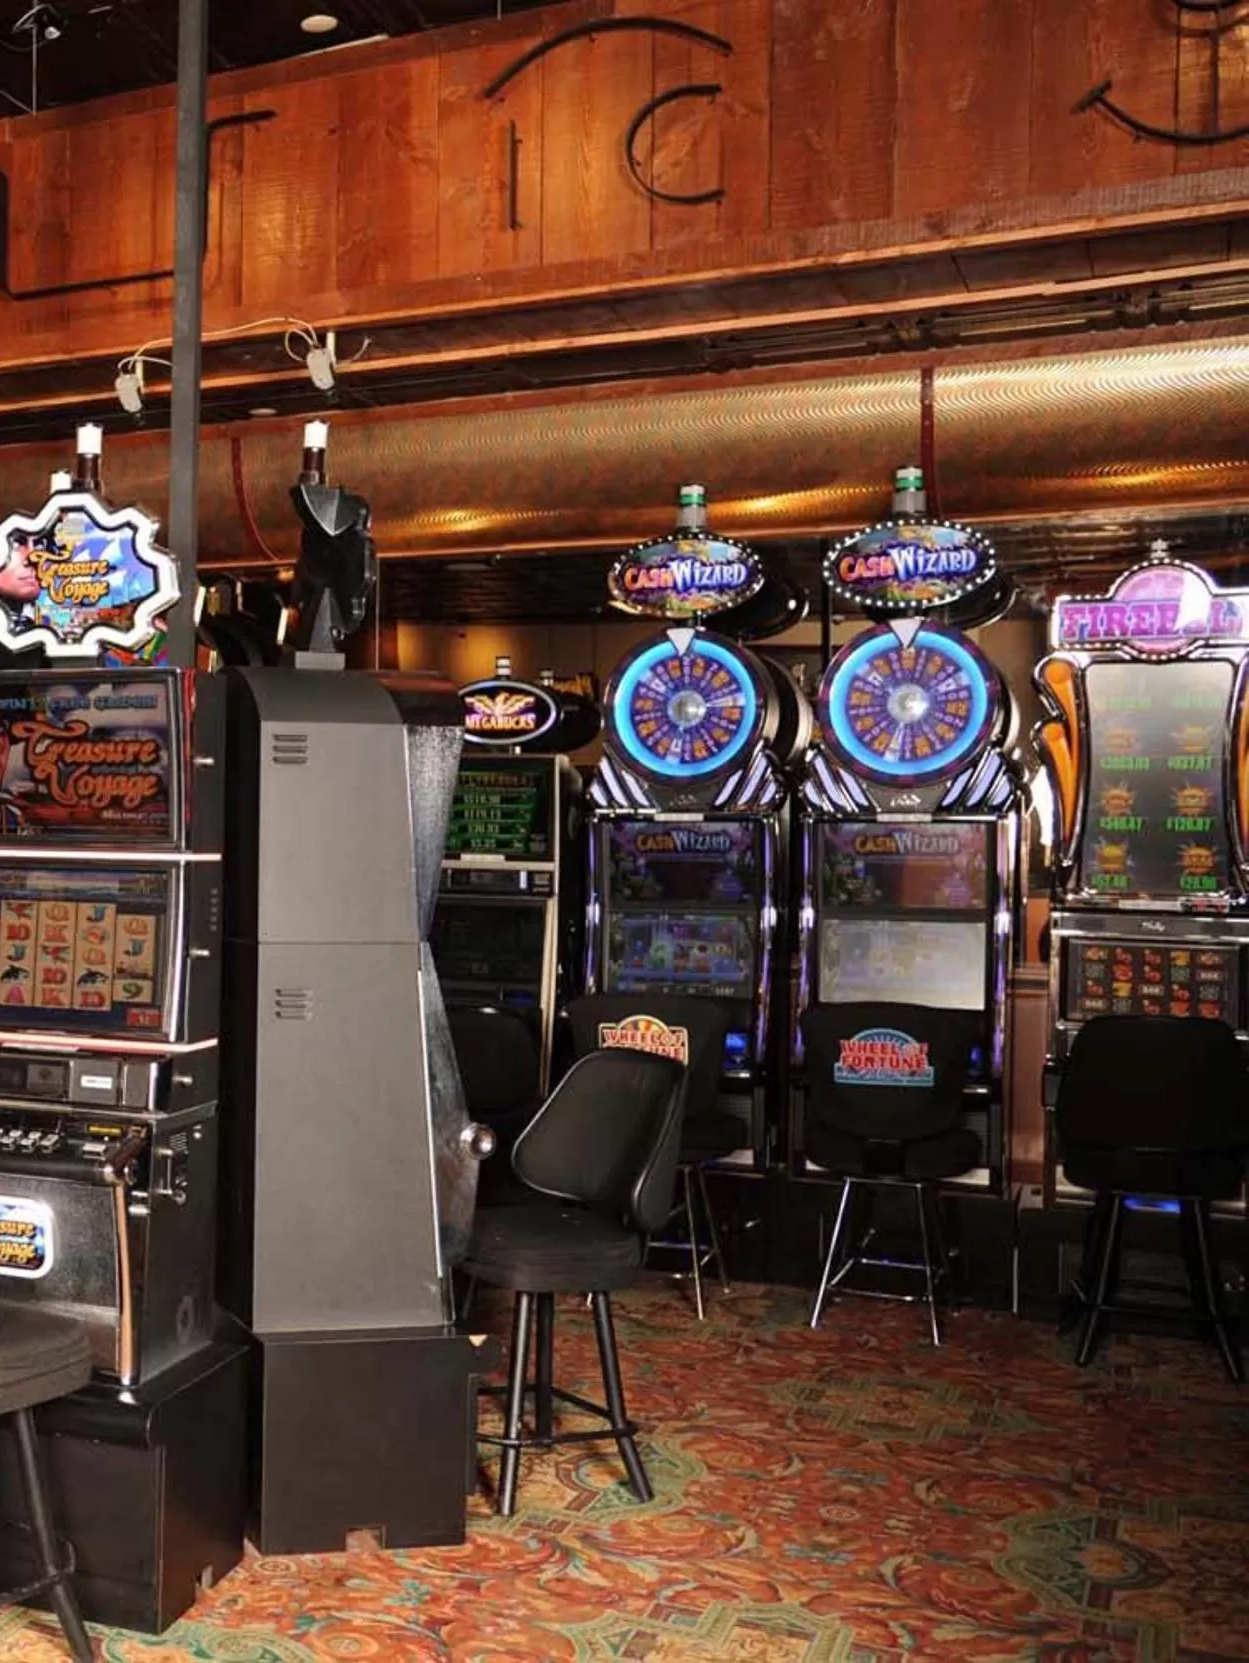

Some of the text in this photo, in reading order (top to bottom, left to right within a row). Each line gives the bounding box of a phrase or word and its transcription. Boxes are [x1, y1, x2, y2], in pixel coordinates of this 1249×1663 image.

[29, 550, 109, 587] Treasure
[50, 577, 109, 604] Voyage
[11, 720, 157, 779] Treasure
[49, 765, 158, 809] Voyage
[839, 1039, 897, 1055] WHEEL
[841, 1053, 928, 1070] FORTUNE
